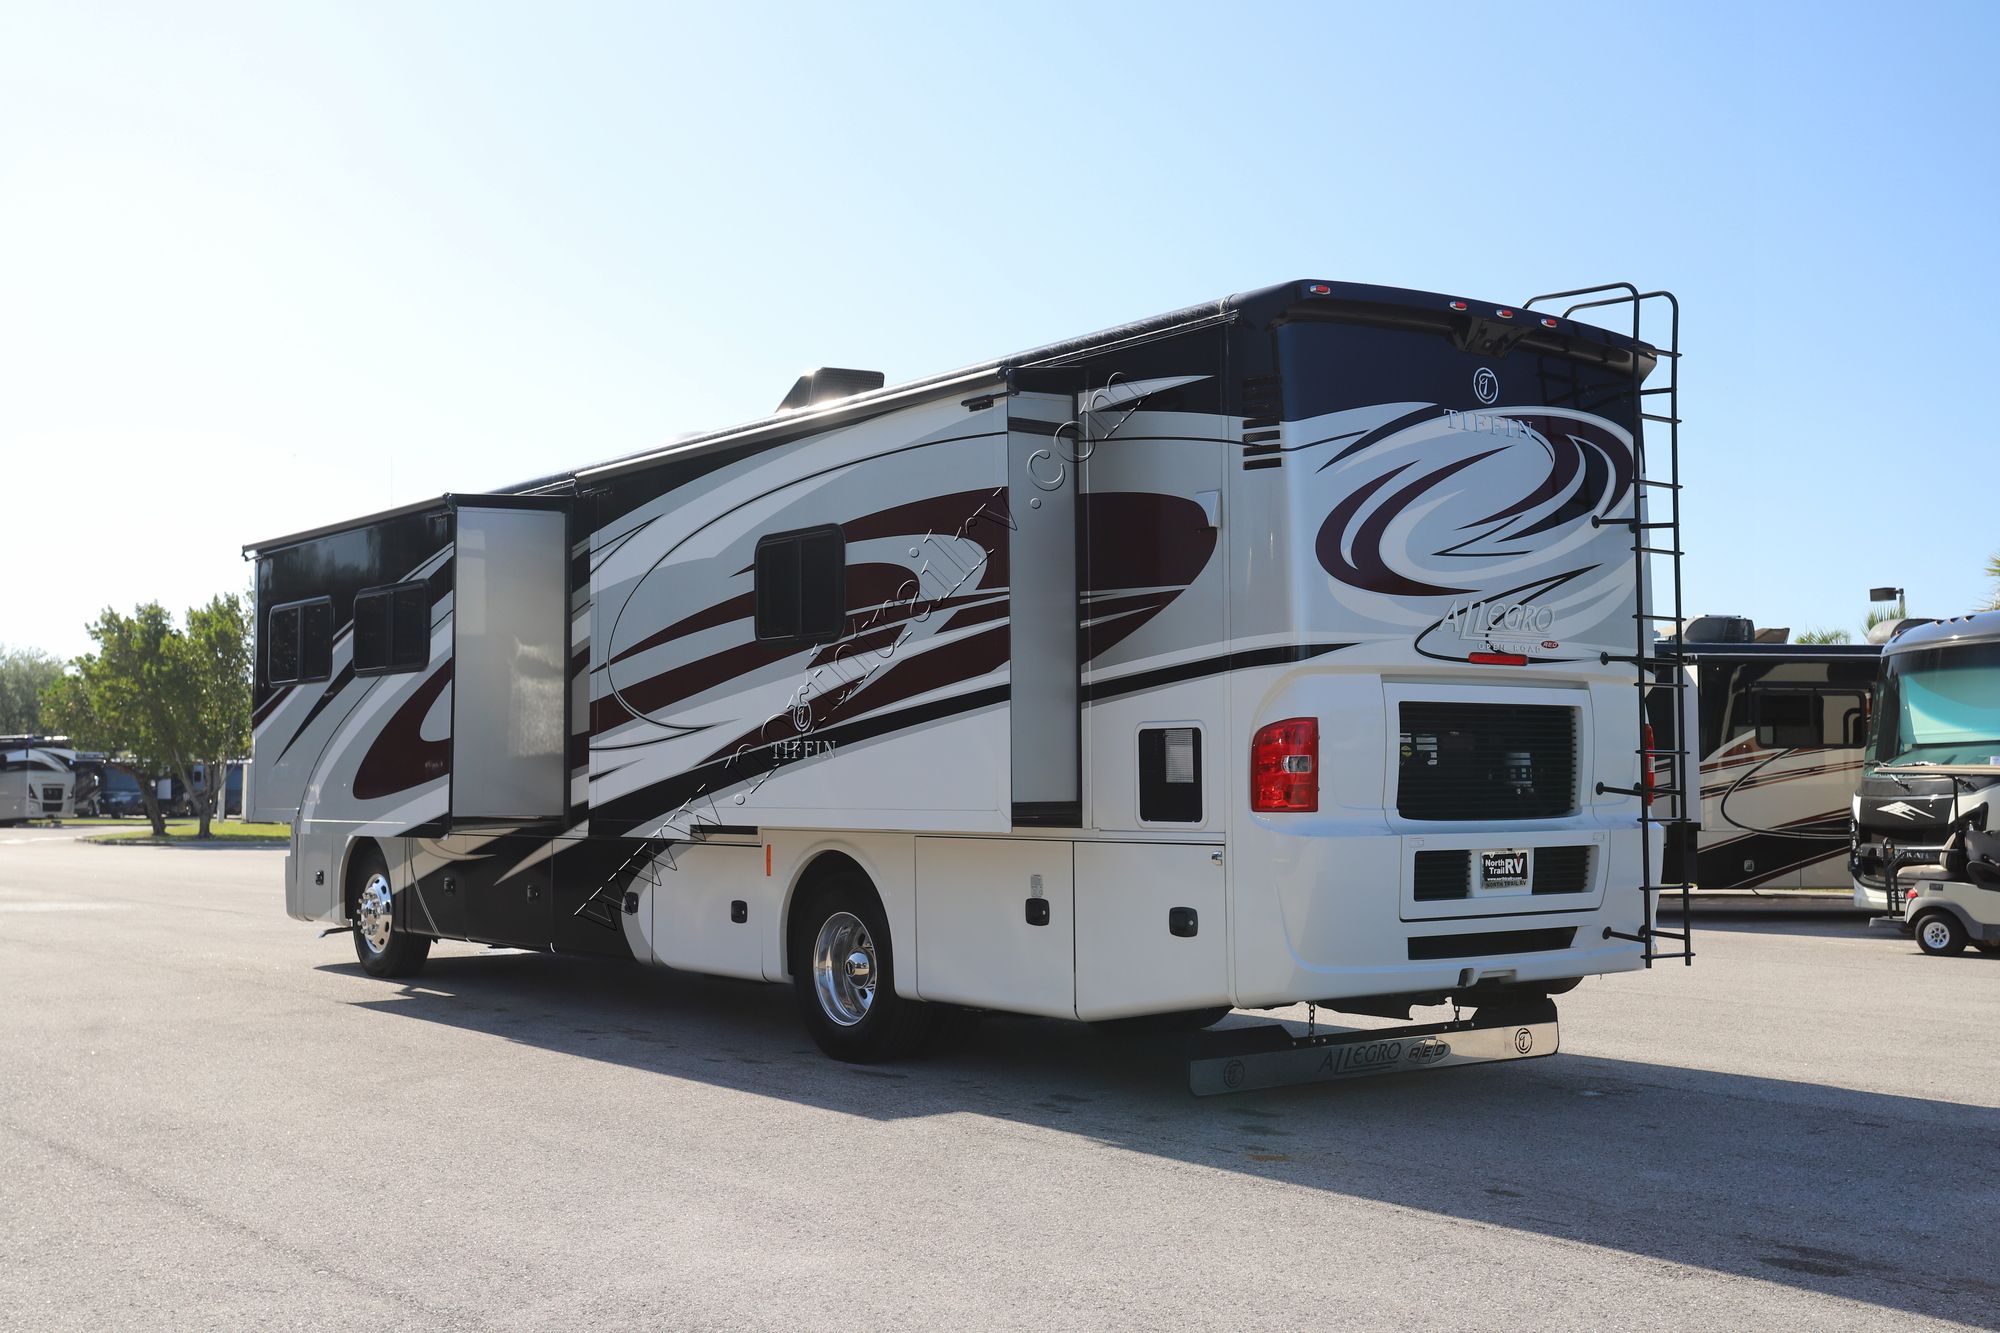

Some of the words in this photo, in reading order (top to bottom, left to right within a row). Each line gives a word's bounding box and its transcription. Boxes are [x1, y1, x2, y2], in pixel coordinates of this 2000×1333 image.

[1443, 408, 1533, 440] TIFFIN
[1435, 600, 1555, 641] ALLEGRO
[1542, 641, 1558, 649] RED
[770, 740, 837, 759] TIFFIN
[1485, 859, 1505, 867] North
[1505, 859, 1523, 874] RV
[1318, 1042, 1402, 1075] ALLEGRO
[1408, 1043, 1446, 1059] RED
